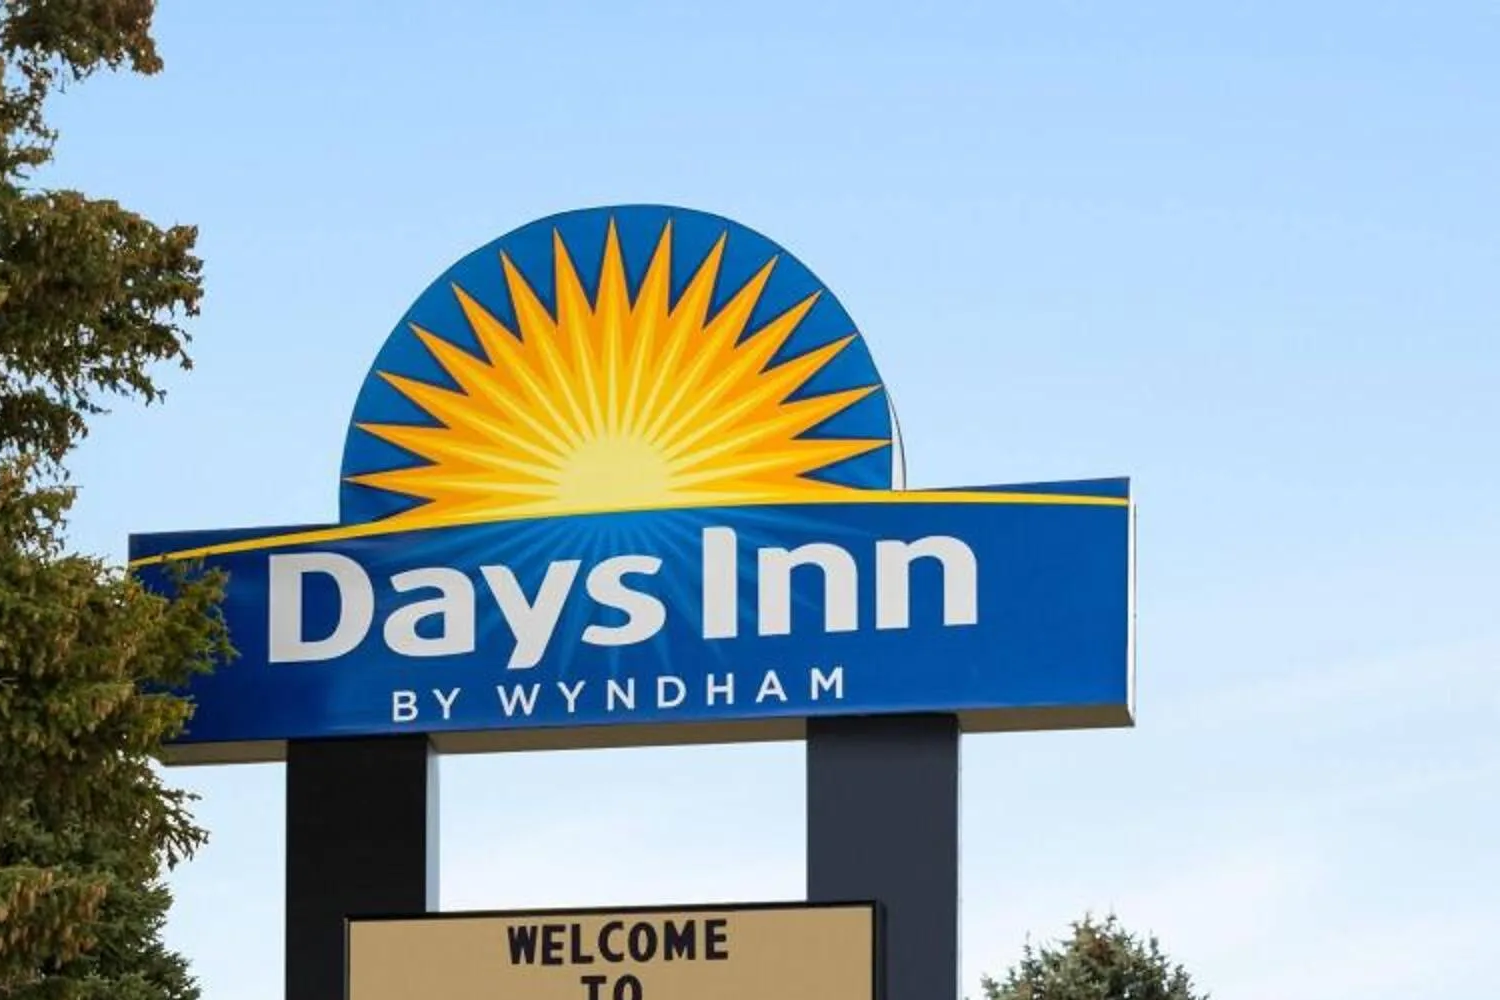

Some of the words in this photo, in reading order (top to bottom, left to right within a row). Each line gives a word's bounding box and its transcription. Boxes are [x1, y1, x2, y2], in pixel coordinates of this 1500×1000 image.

[267, 552, 667, 670] Days
[702, 526, 978, 640] Inn
[392, 687, 460, 723] BY
[497, 666, 844, 718] WYNDHAM
[507, 918, 730, 967] WELCOME
